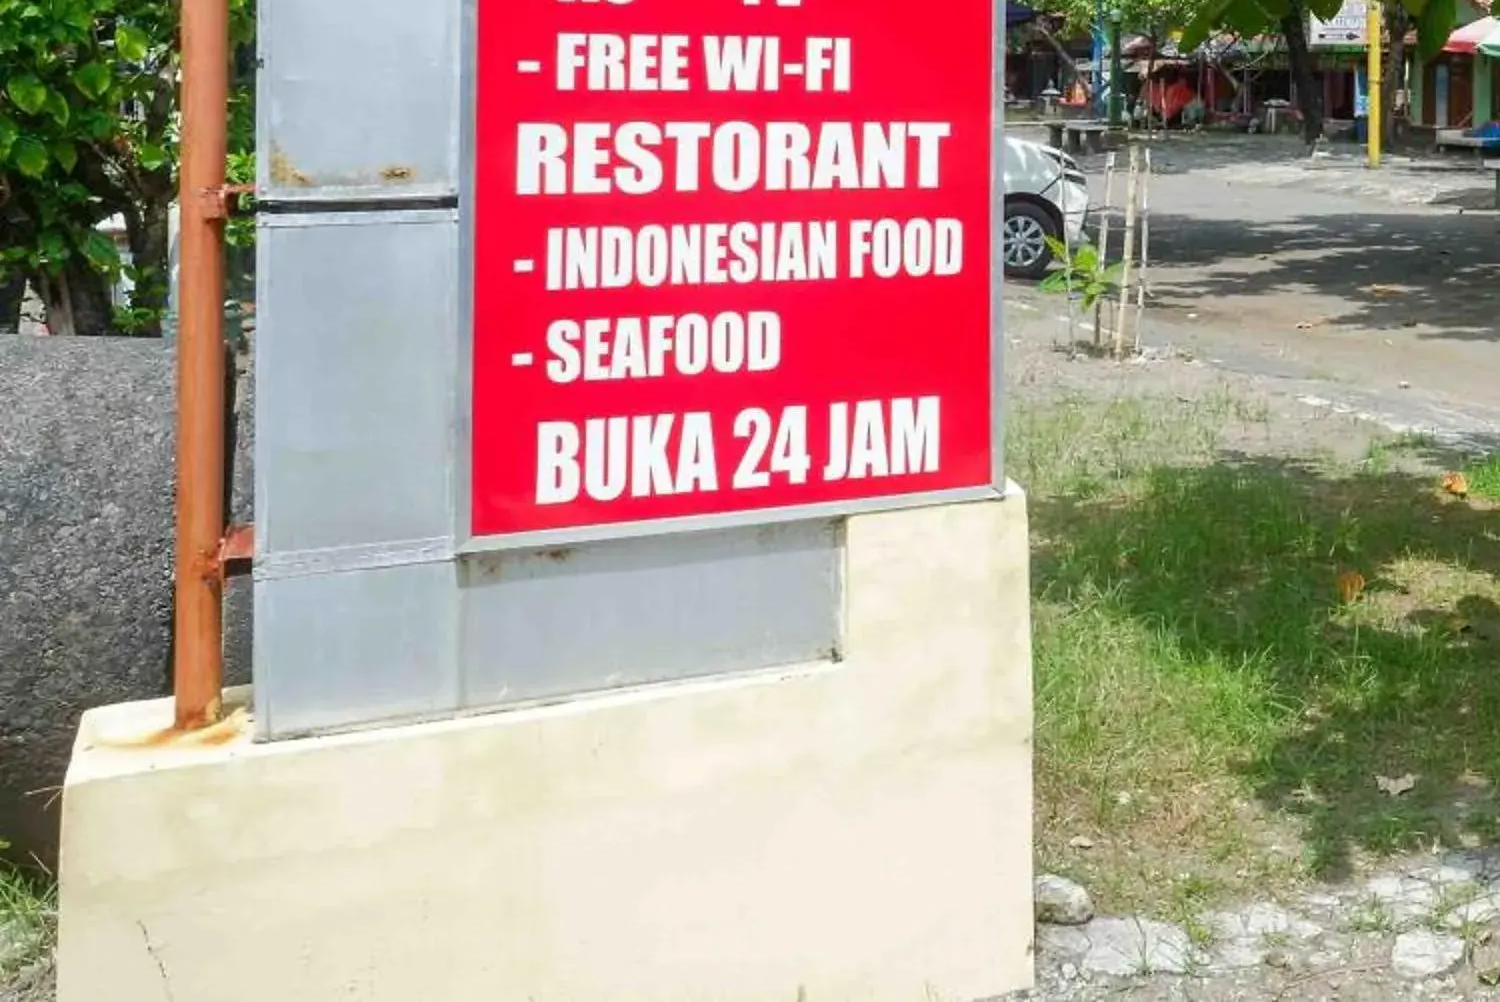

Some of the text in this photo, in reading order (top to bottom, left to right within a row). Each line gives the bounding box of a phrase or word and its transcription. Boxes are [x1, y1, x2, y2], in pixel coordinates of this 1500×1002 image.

[557, 33, 850, 91] FREE WI-FI
[517, 121, 950, 194] RESTORANT
[547, 218, 962, 290] INDONESIAN FOOD
[547, 311, 780, 382] SEAFOOD
[536, 396, 940, 504] BUKA 24 JAM
